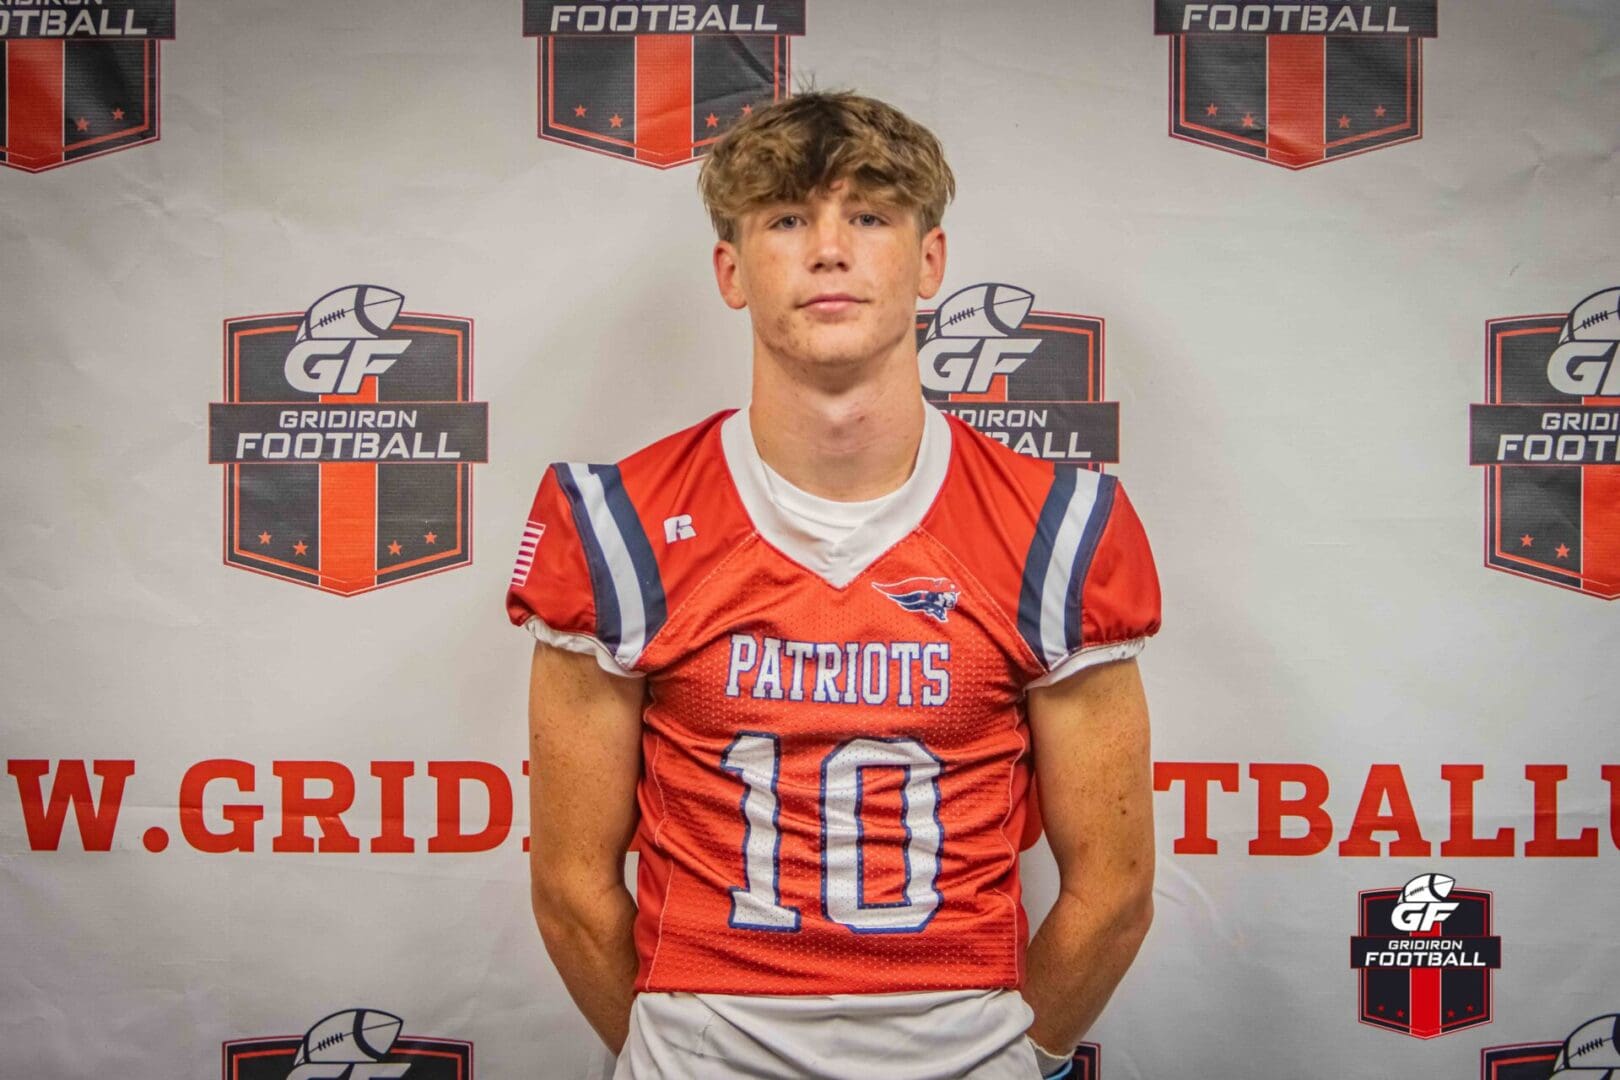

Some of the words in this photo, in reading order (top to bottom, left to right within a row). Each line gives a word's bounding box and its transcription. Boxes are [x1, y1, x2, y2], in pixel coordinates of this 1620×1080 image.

[550, 4, 778, 32] FOOTBALL
[1182, 5, 1410, 33] FOOTBALL
[284, 339, 412, 394] GF
[917, 338, 1043, 393] GF
[279, 410, 417, 429] GRIDIRON
[236, 432, 460, 459] FOOTBALL
[1497, 434, 1620, 461] FOOT
[725, 633, 951, 707] PATRIOTS
[7, 759, 530, 853] W.GRID
[1153, 761, 1620, 858] TBALL
[721, 730, 944, 933] 10
